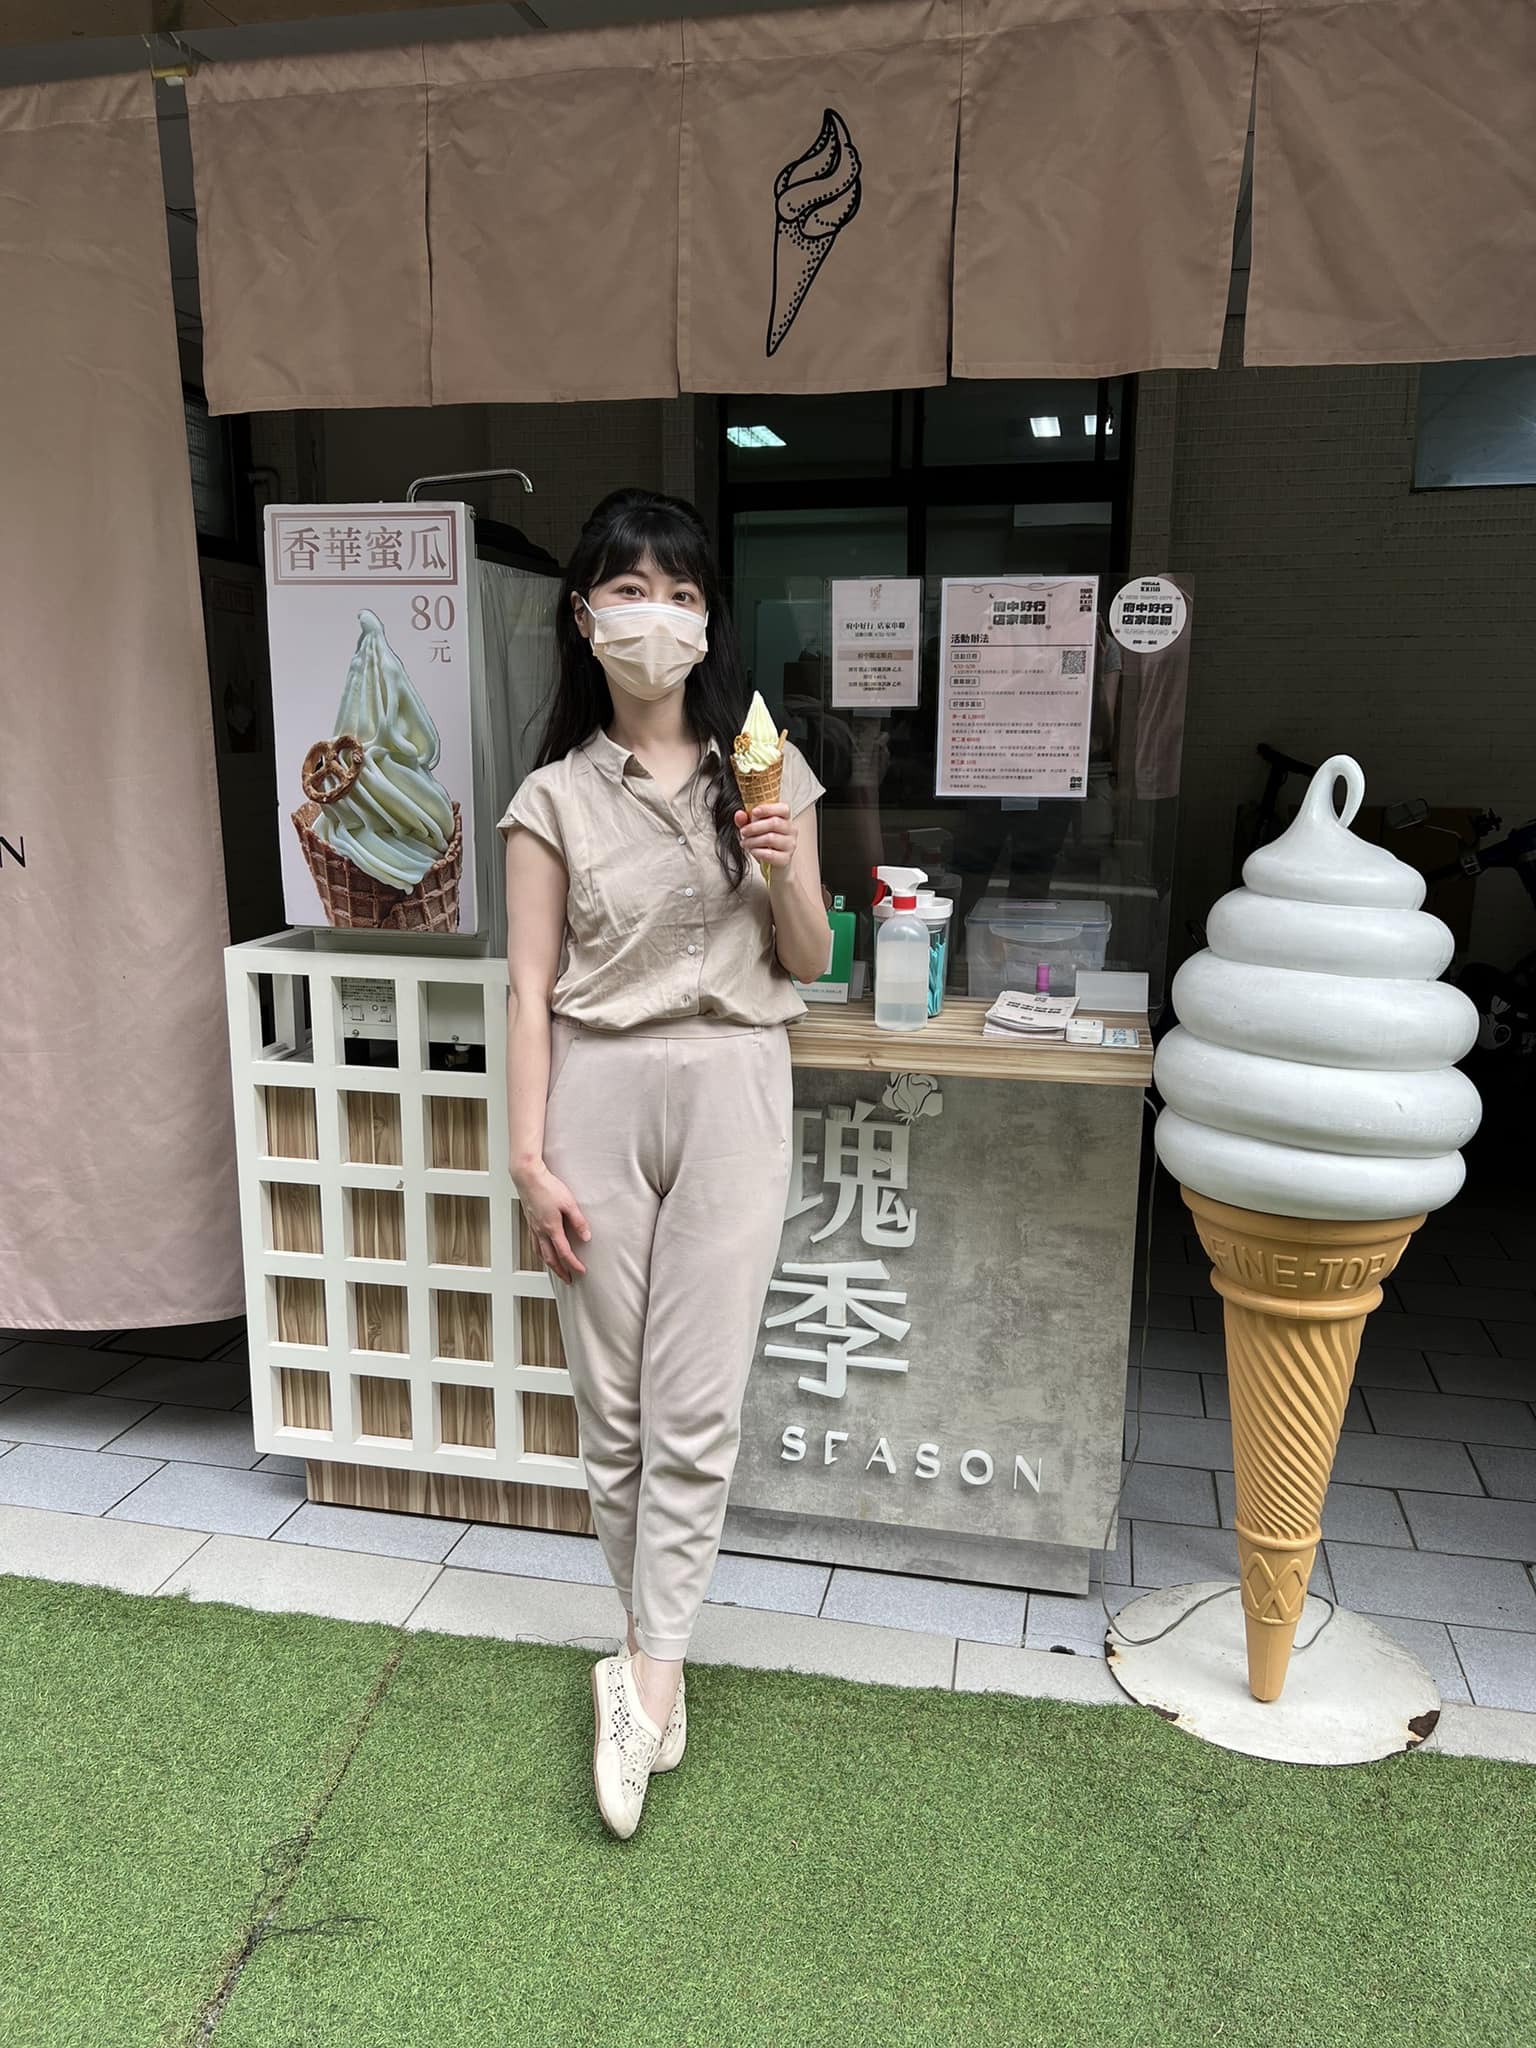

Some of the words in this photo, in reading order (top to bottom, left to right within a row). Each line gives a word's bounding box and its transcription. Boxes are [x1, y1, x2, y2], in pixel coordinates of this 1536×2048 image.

[282, 525, 447, 571] 香華蜜瓜
[410, 594, 455, 631] 80
[1123, 602, 1173, 613] 府中好行
[431, 640, 452, 663] 元
[1208, 1236, 1388, 1292] FINE-TOP
[780, 1425, 1043, 1494] SEASON
